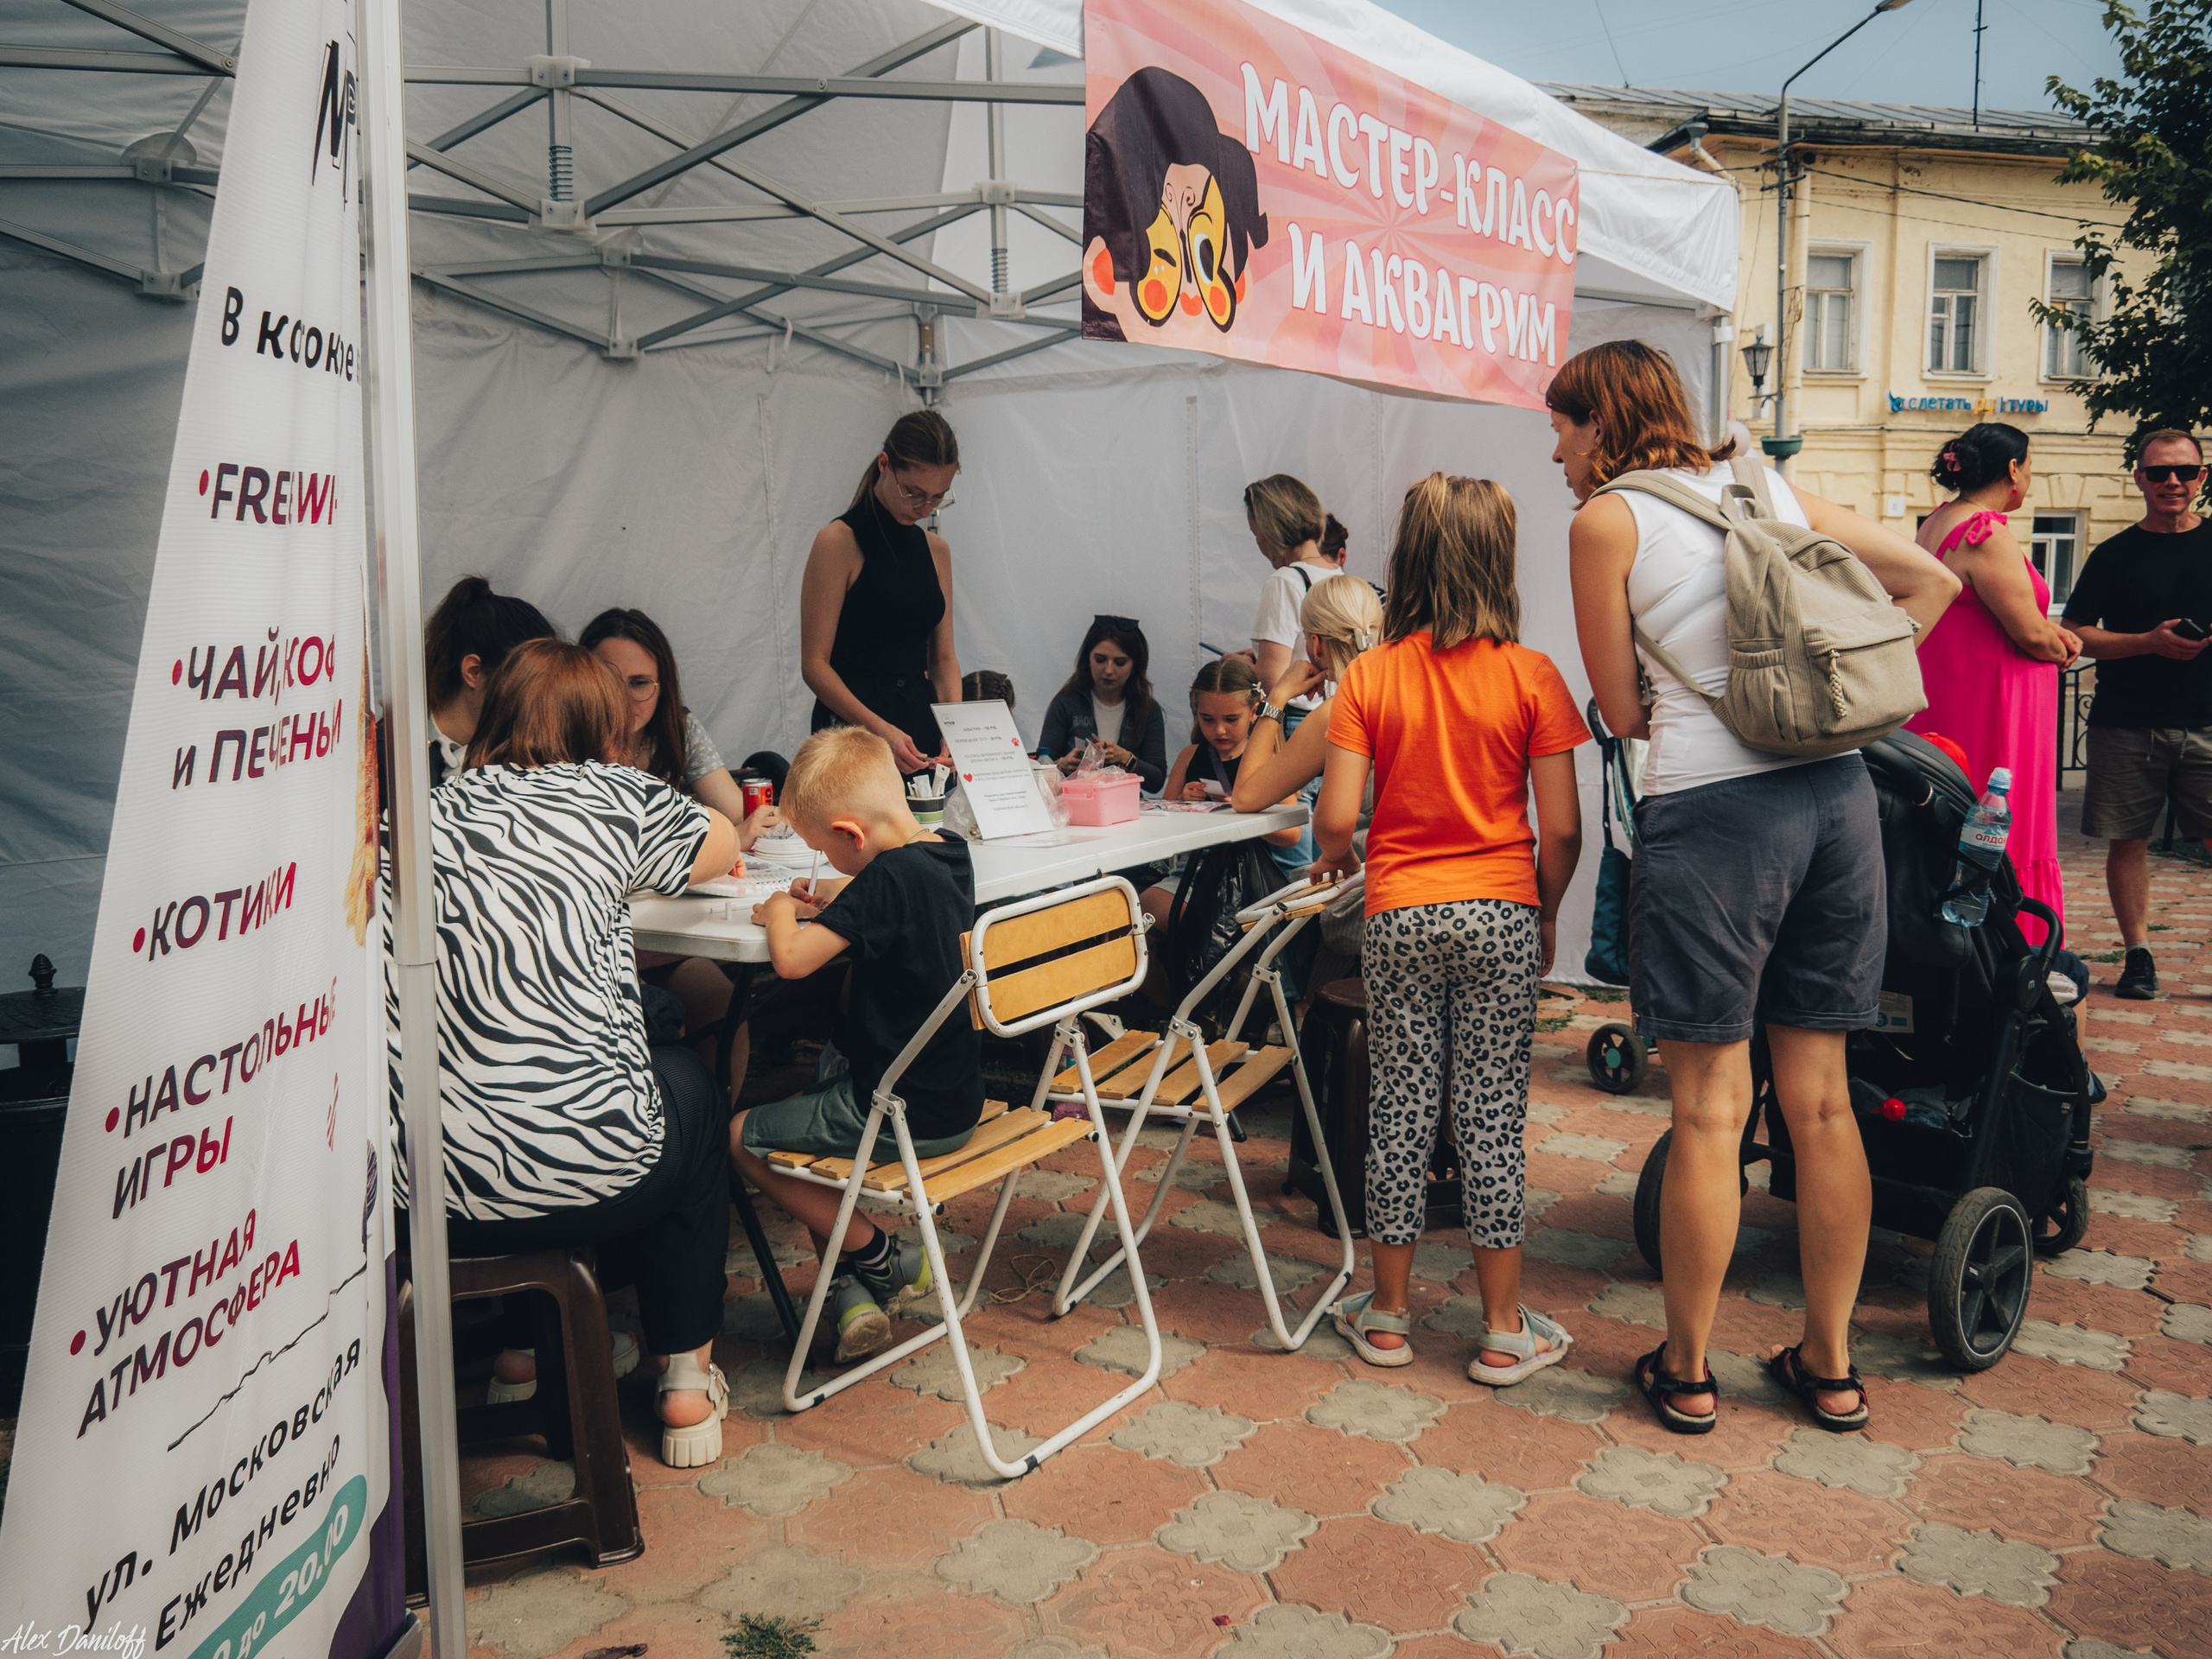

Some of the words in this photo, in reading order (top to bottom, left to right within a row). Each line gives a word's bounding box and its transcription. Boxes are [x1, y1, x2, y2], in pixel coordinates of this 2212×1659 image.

[1239, 61, 1576, 265] МАСТЕР-КЛАСС
[221, 286, 244, 346] В
[1287, 222, 1327, 315] И
[1340, 239, 1556, 367] АКВАГРИМ
[149, 861, 297, 962] КОТИКИ
[124, 976, 337, 1140] НАСТОЛЬНЫЕ
[111, 1115, 234, 1220] ИГРЫ
[77, 1238, 302, 1440] АТМОСФЕРА
[94, 1208, 257, 1357] УЮТНАЯ
[84, 1549, 154, 1636] ул.
[168, 1338, 361, 1557] Московская
[155, 1434, 341, 1652] Ежедневно
